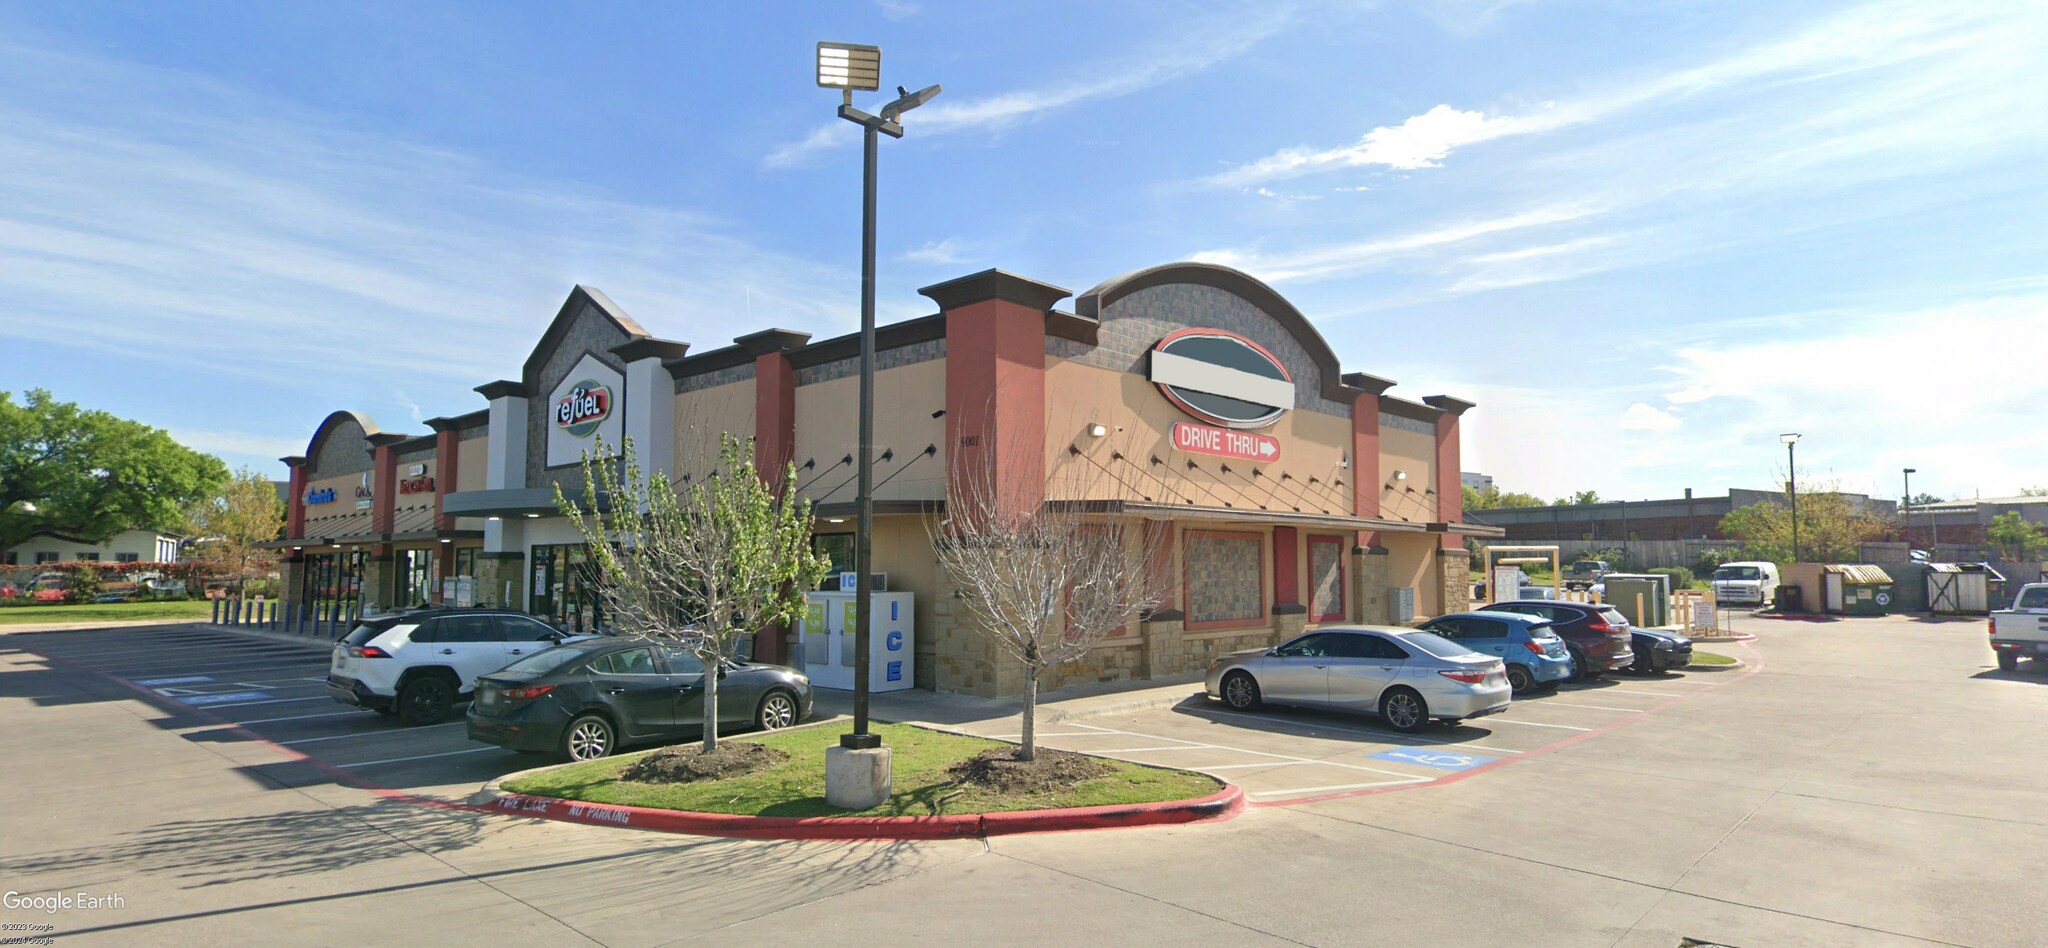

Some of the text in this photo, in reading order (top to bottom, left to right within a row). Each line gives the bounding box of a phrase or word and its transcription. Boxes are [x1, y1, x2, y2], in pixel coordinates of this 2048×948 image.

[1181, 425, 1259, 456] DRIVE THRU
[842, 574, 856, 588] IC
[886, 600, 903, 682] ICE
[498, 796, 632, 824] FIRE LANE NO PARKING
